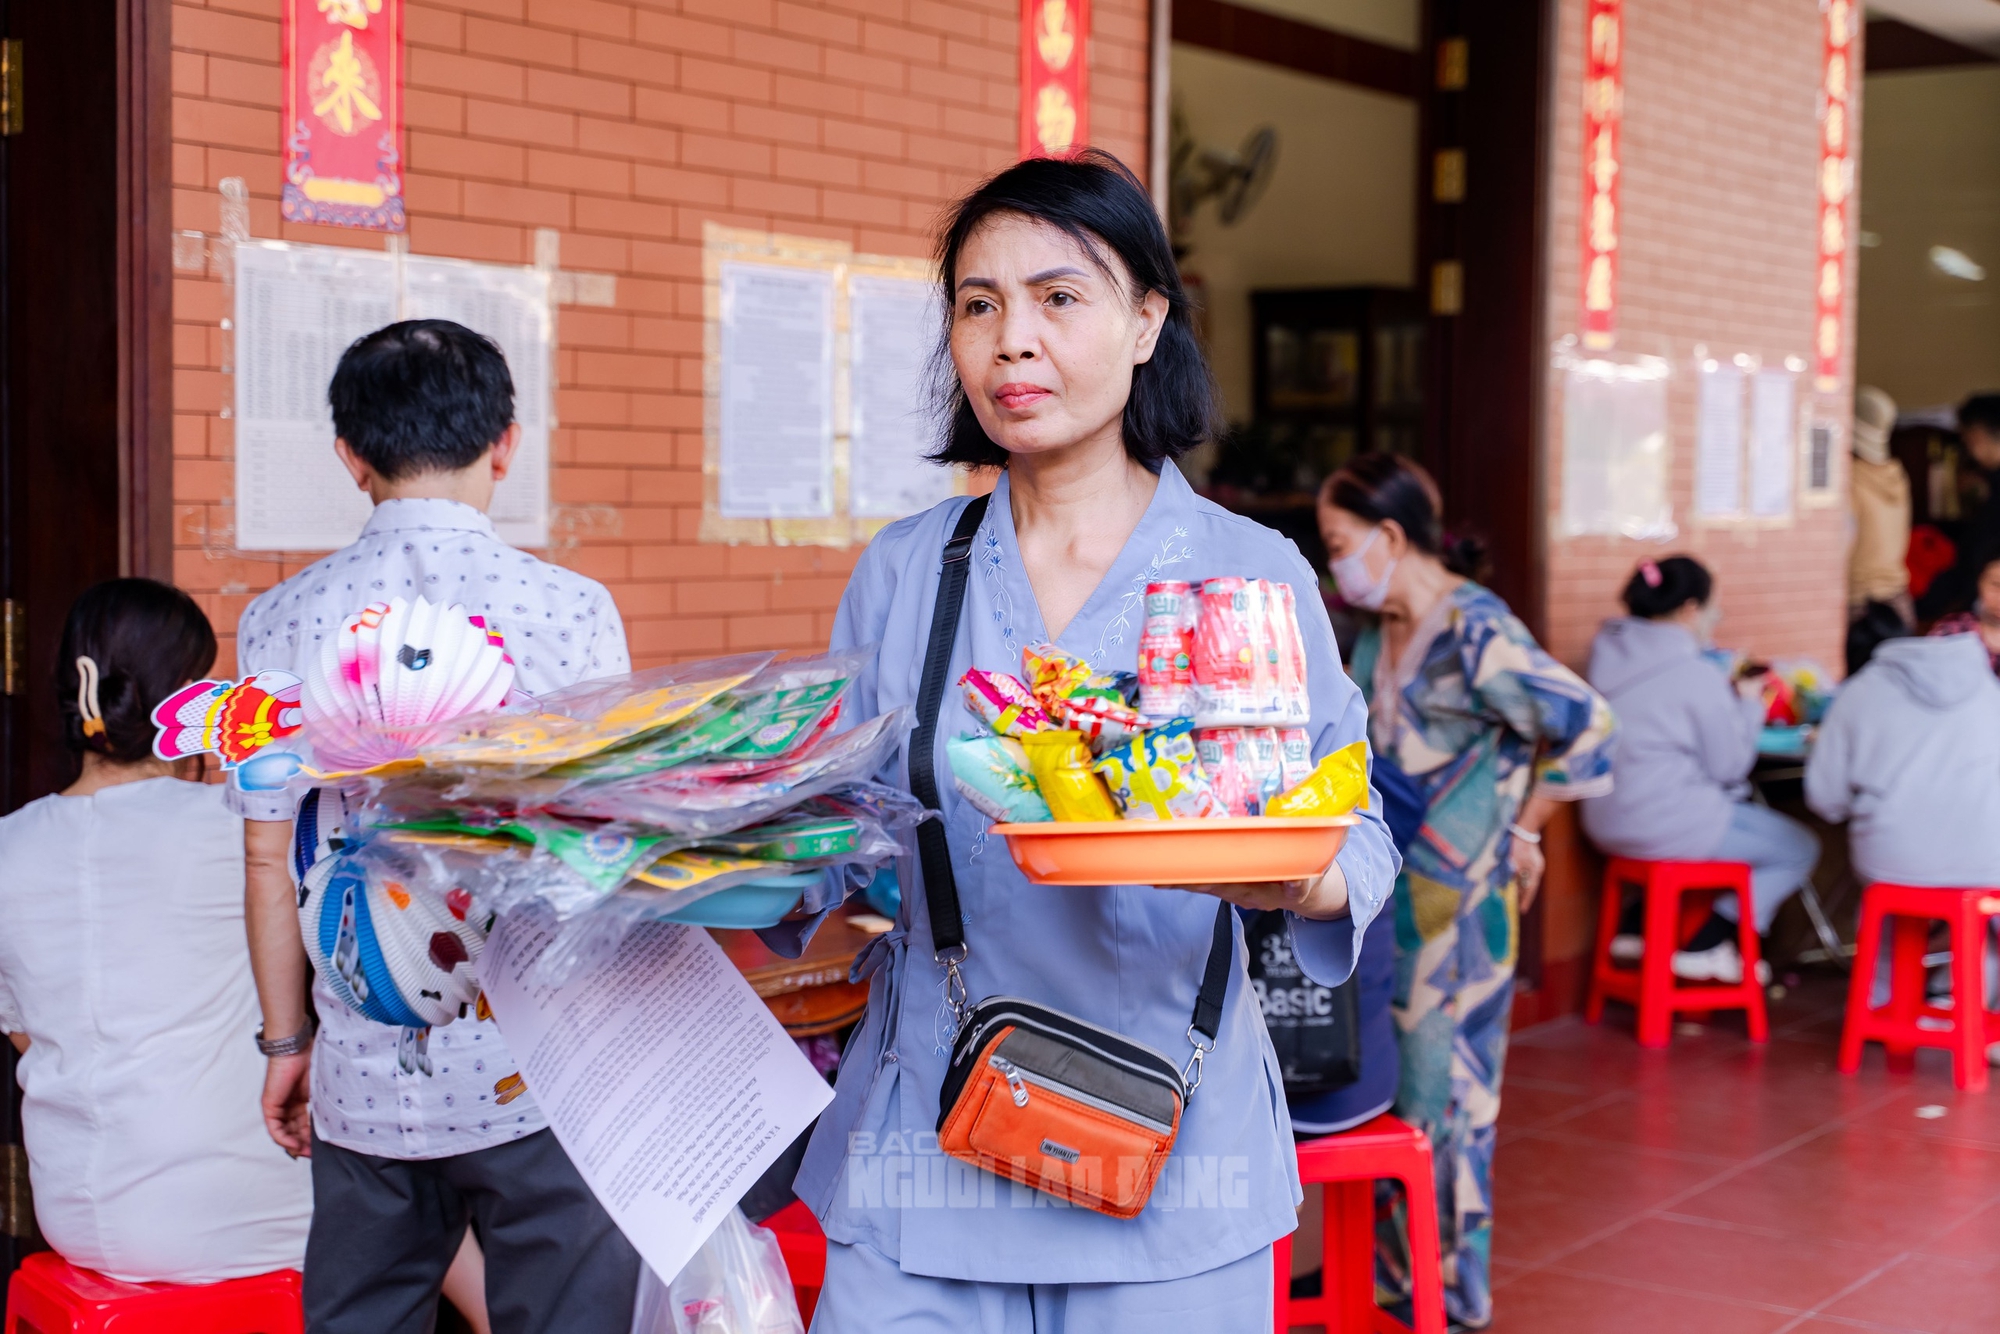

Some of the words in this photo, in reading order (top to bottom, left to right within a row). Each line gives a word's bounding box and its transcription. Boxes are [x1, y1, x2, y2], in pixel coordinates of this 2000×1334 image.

[1251, 977, 1333, 1017] Basic
[764, 1125, 781, 1142] VĂN
[746, 1139, 766, 1162] PHÁT
[718, 1159, 748, 1190] NGUYỆN
[704, 1189, 721, 1209] SÁM
[692, 1206, 707, 1224] HỐI
